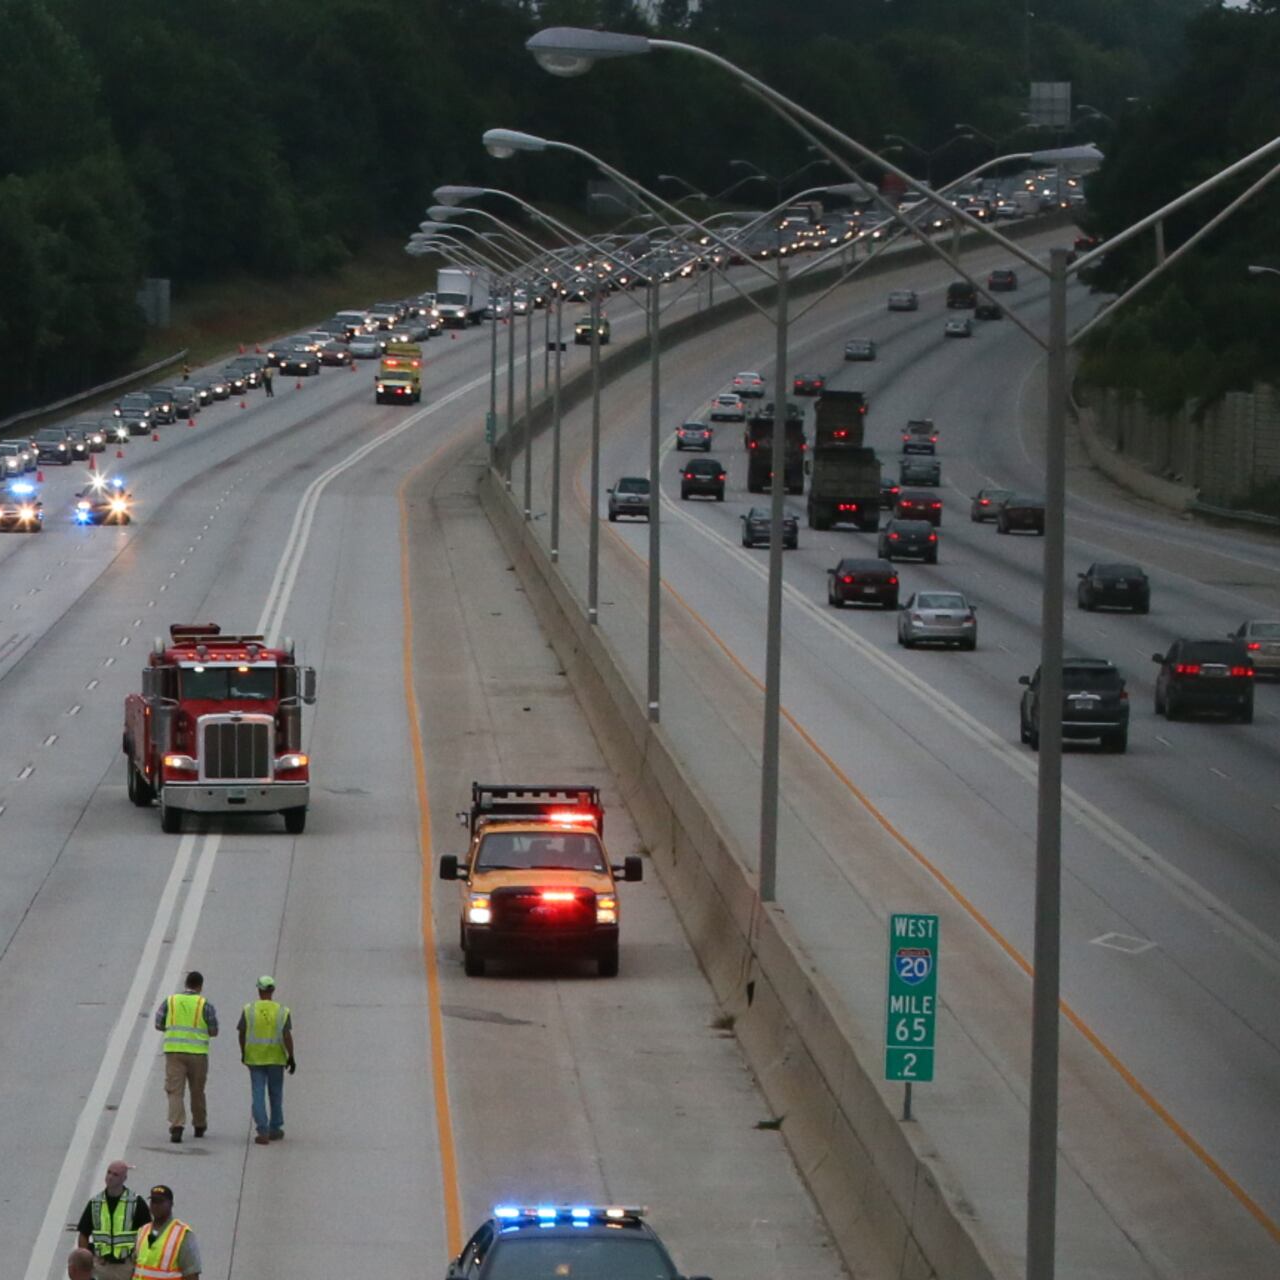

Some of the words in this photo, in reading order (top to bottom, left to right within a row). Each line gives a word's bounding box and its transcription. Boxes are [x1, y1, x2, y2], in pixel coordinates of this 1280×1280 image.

[894, 917, 936, 939] WEST
[900, 957, 929, 977] 20
[890, 995, 934, 1015] MILE
[895, 1018, 927, 1042] 65
